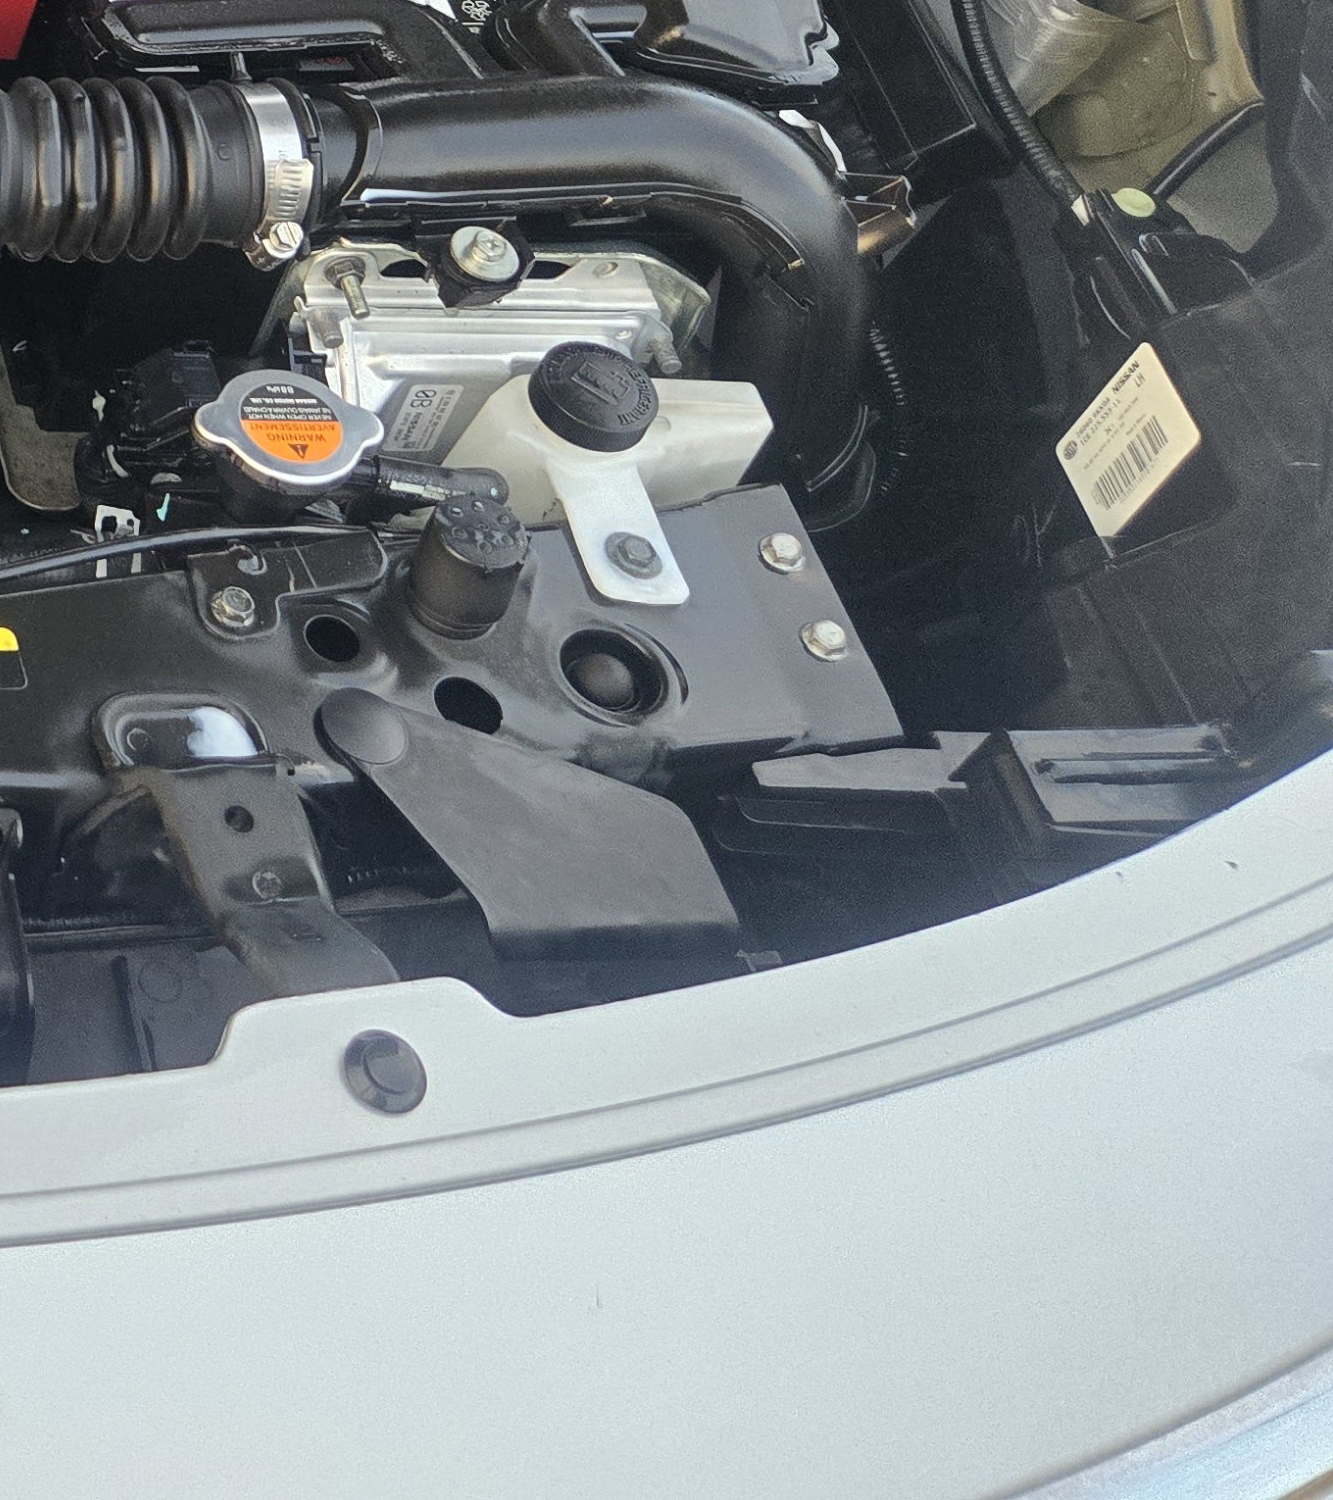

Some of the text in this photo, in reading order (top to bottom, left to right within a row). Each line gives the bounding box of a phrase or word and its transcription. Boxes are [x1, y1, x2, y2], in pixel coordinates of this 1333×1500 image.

[1112, 360, 1140, 394] NISSAN
[1133, 372, 1146, 389] LH
[250, 422, 335, 432] AVERTISSEMENT
[267, 432, 326, 442] WARNING
